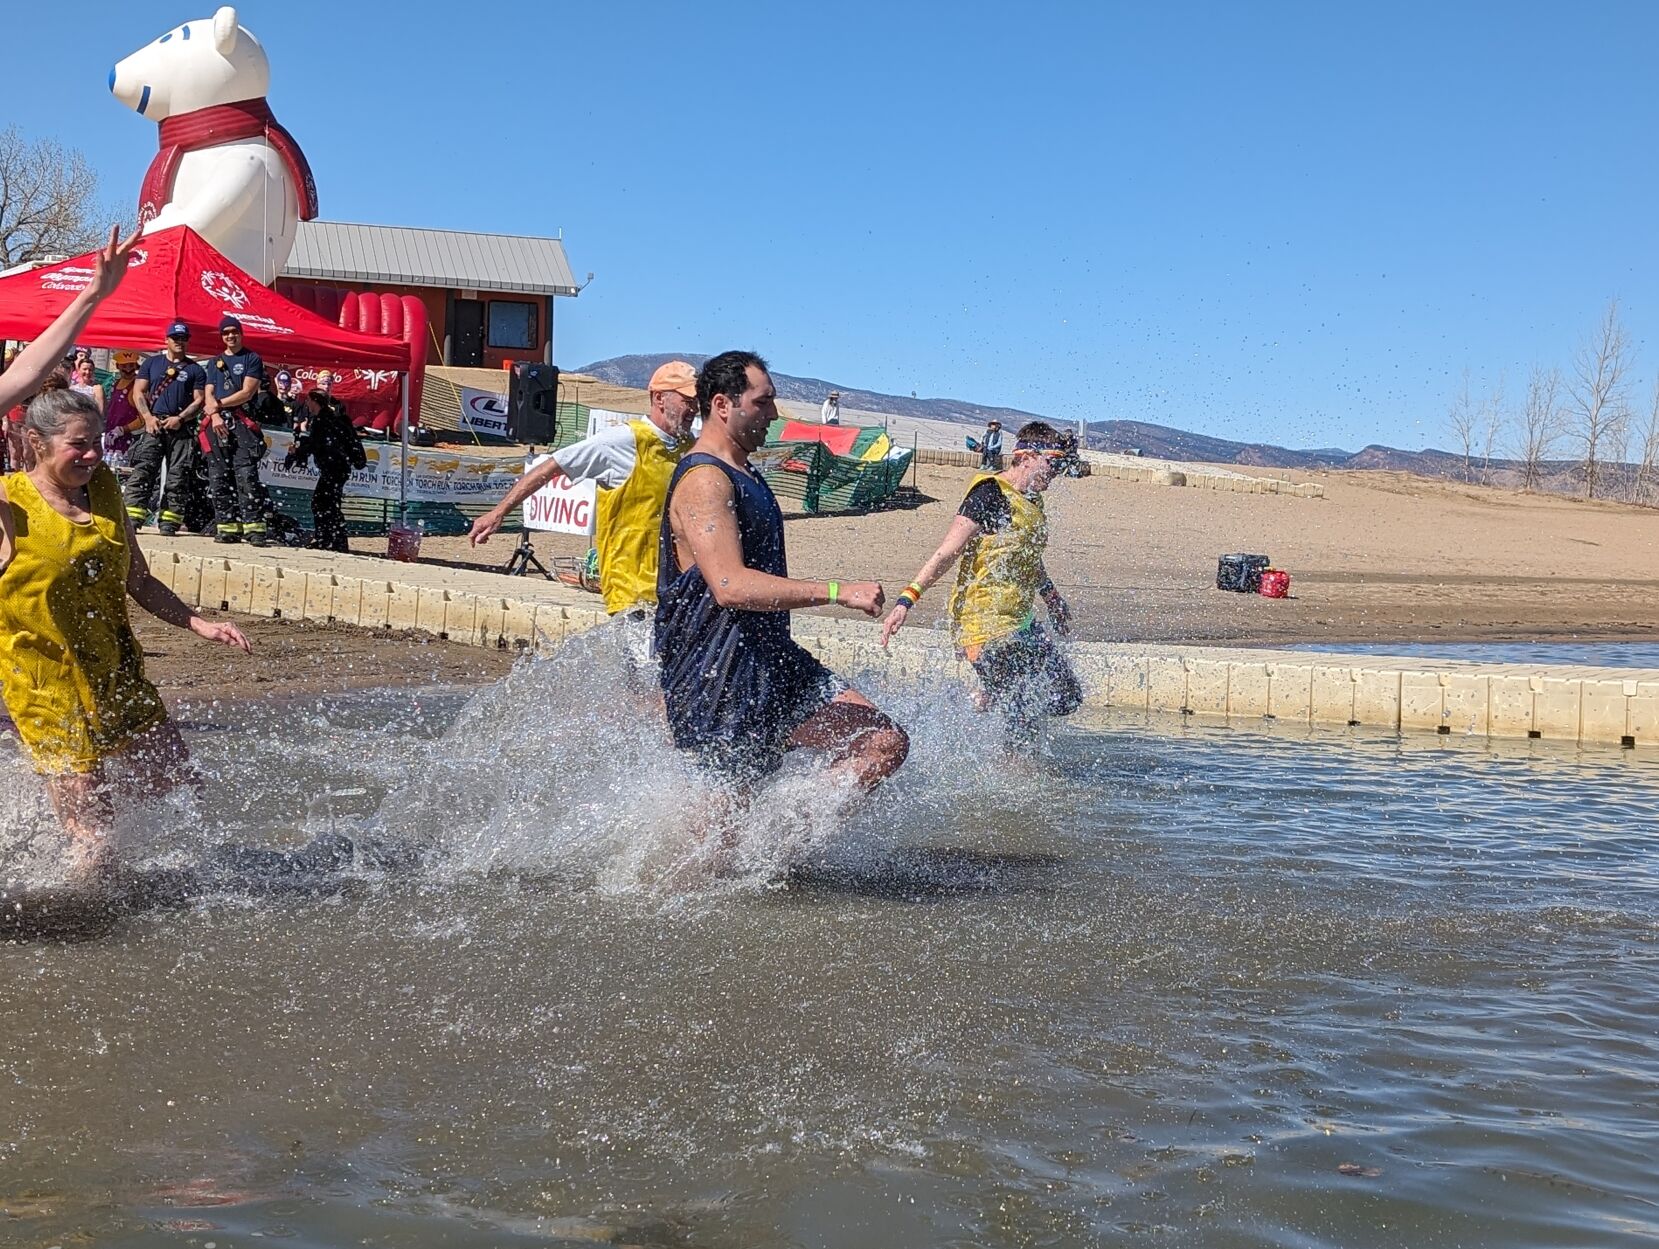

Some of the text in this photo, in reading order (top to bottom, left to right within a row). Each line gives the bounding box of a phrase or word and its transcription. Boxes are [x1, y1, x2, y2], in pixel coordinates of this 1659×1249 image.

[59, 266, 97, 274] Spec
[295, 368, 342, 383] Coloo
[462, 416, 508, 432] LIBERT
[359, 472, 378, 484] RUN
[415, 478, 437, 490] TORCH
[529, 494, 589, 527] DIVING
